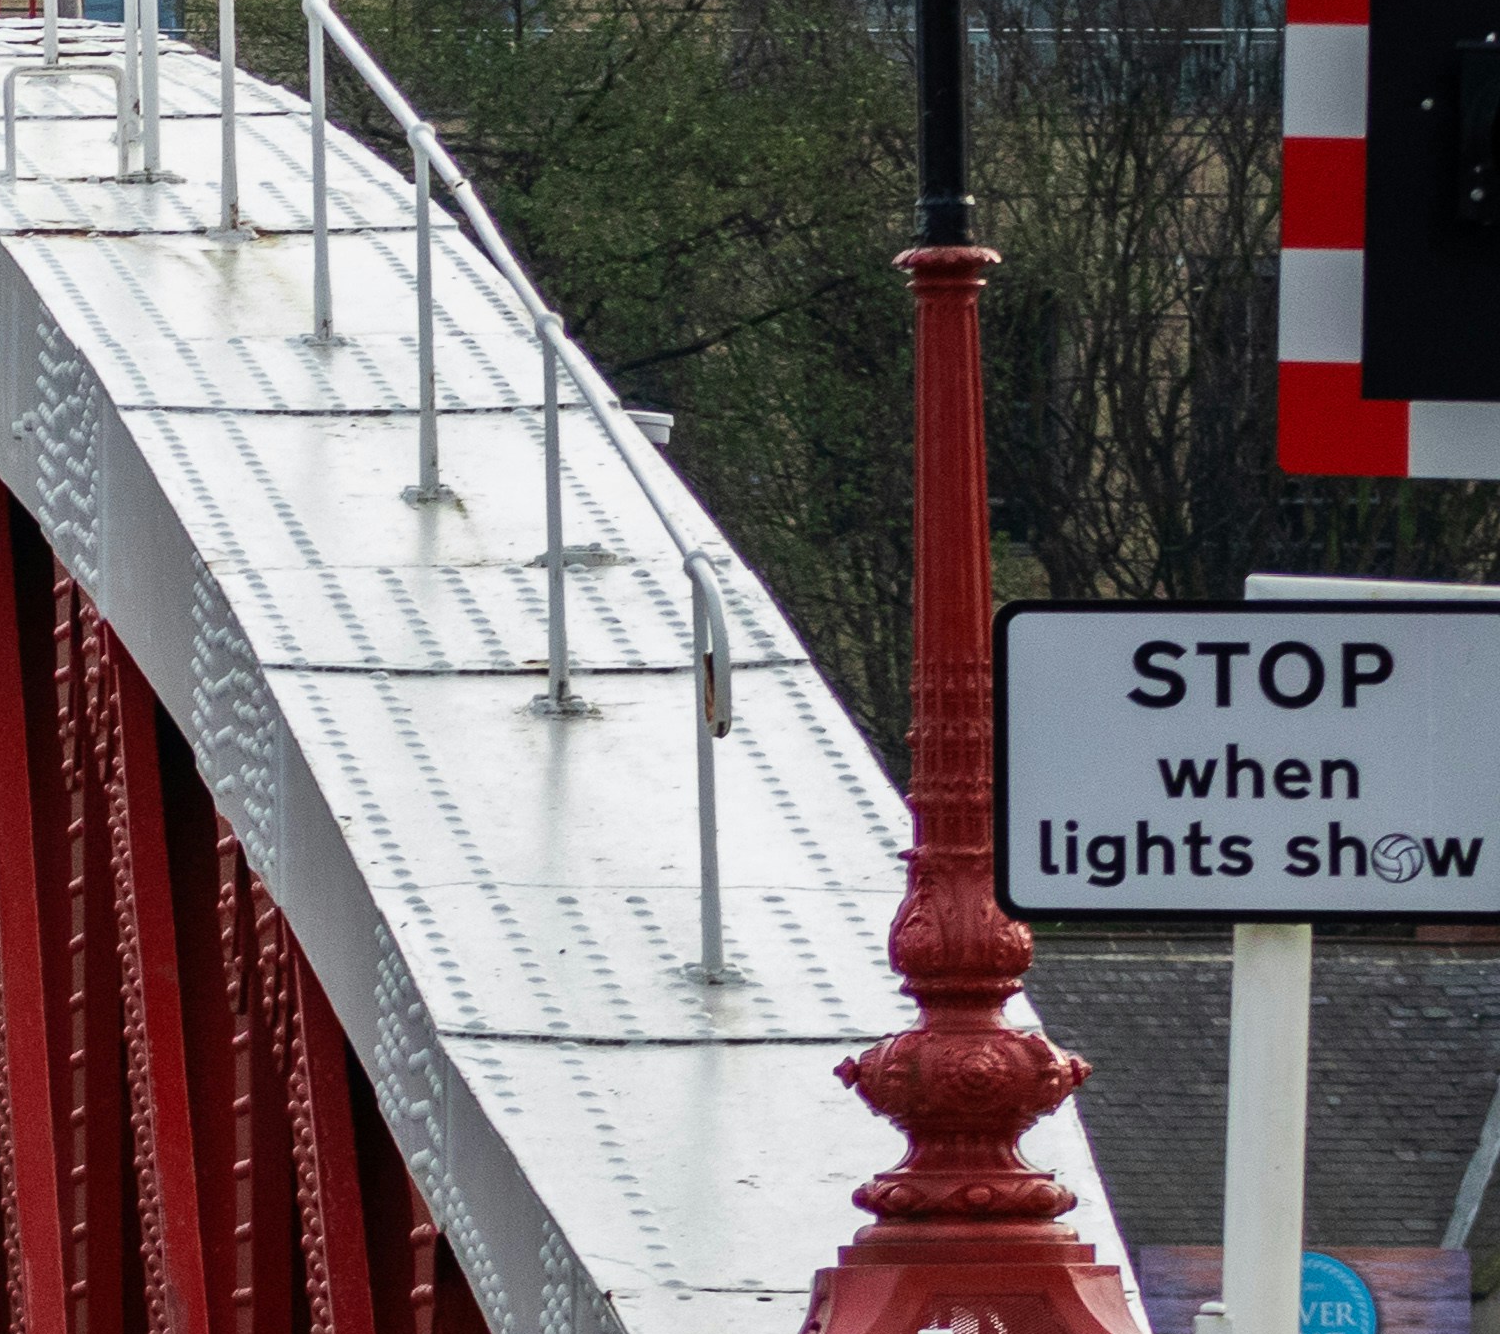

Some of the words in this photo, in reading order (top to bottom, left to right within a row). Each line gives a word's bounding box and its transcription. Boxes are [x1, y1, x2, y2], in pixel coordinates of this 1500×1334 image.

[1127, 639, 1395, 710] STOP
[1157, 743, 1360, 800] when
[1039, 819, 1254, 888] lights
[1284, 821, 1484, 884] shw
